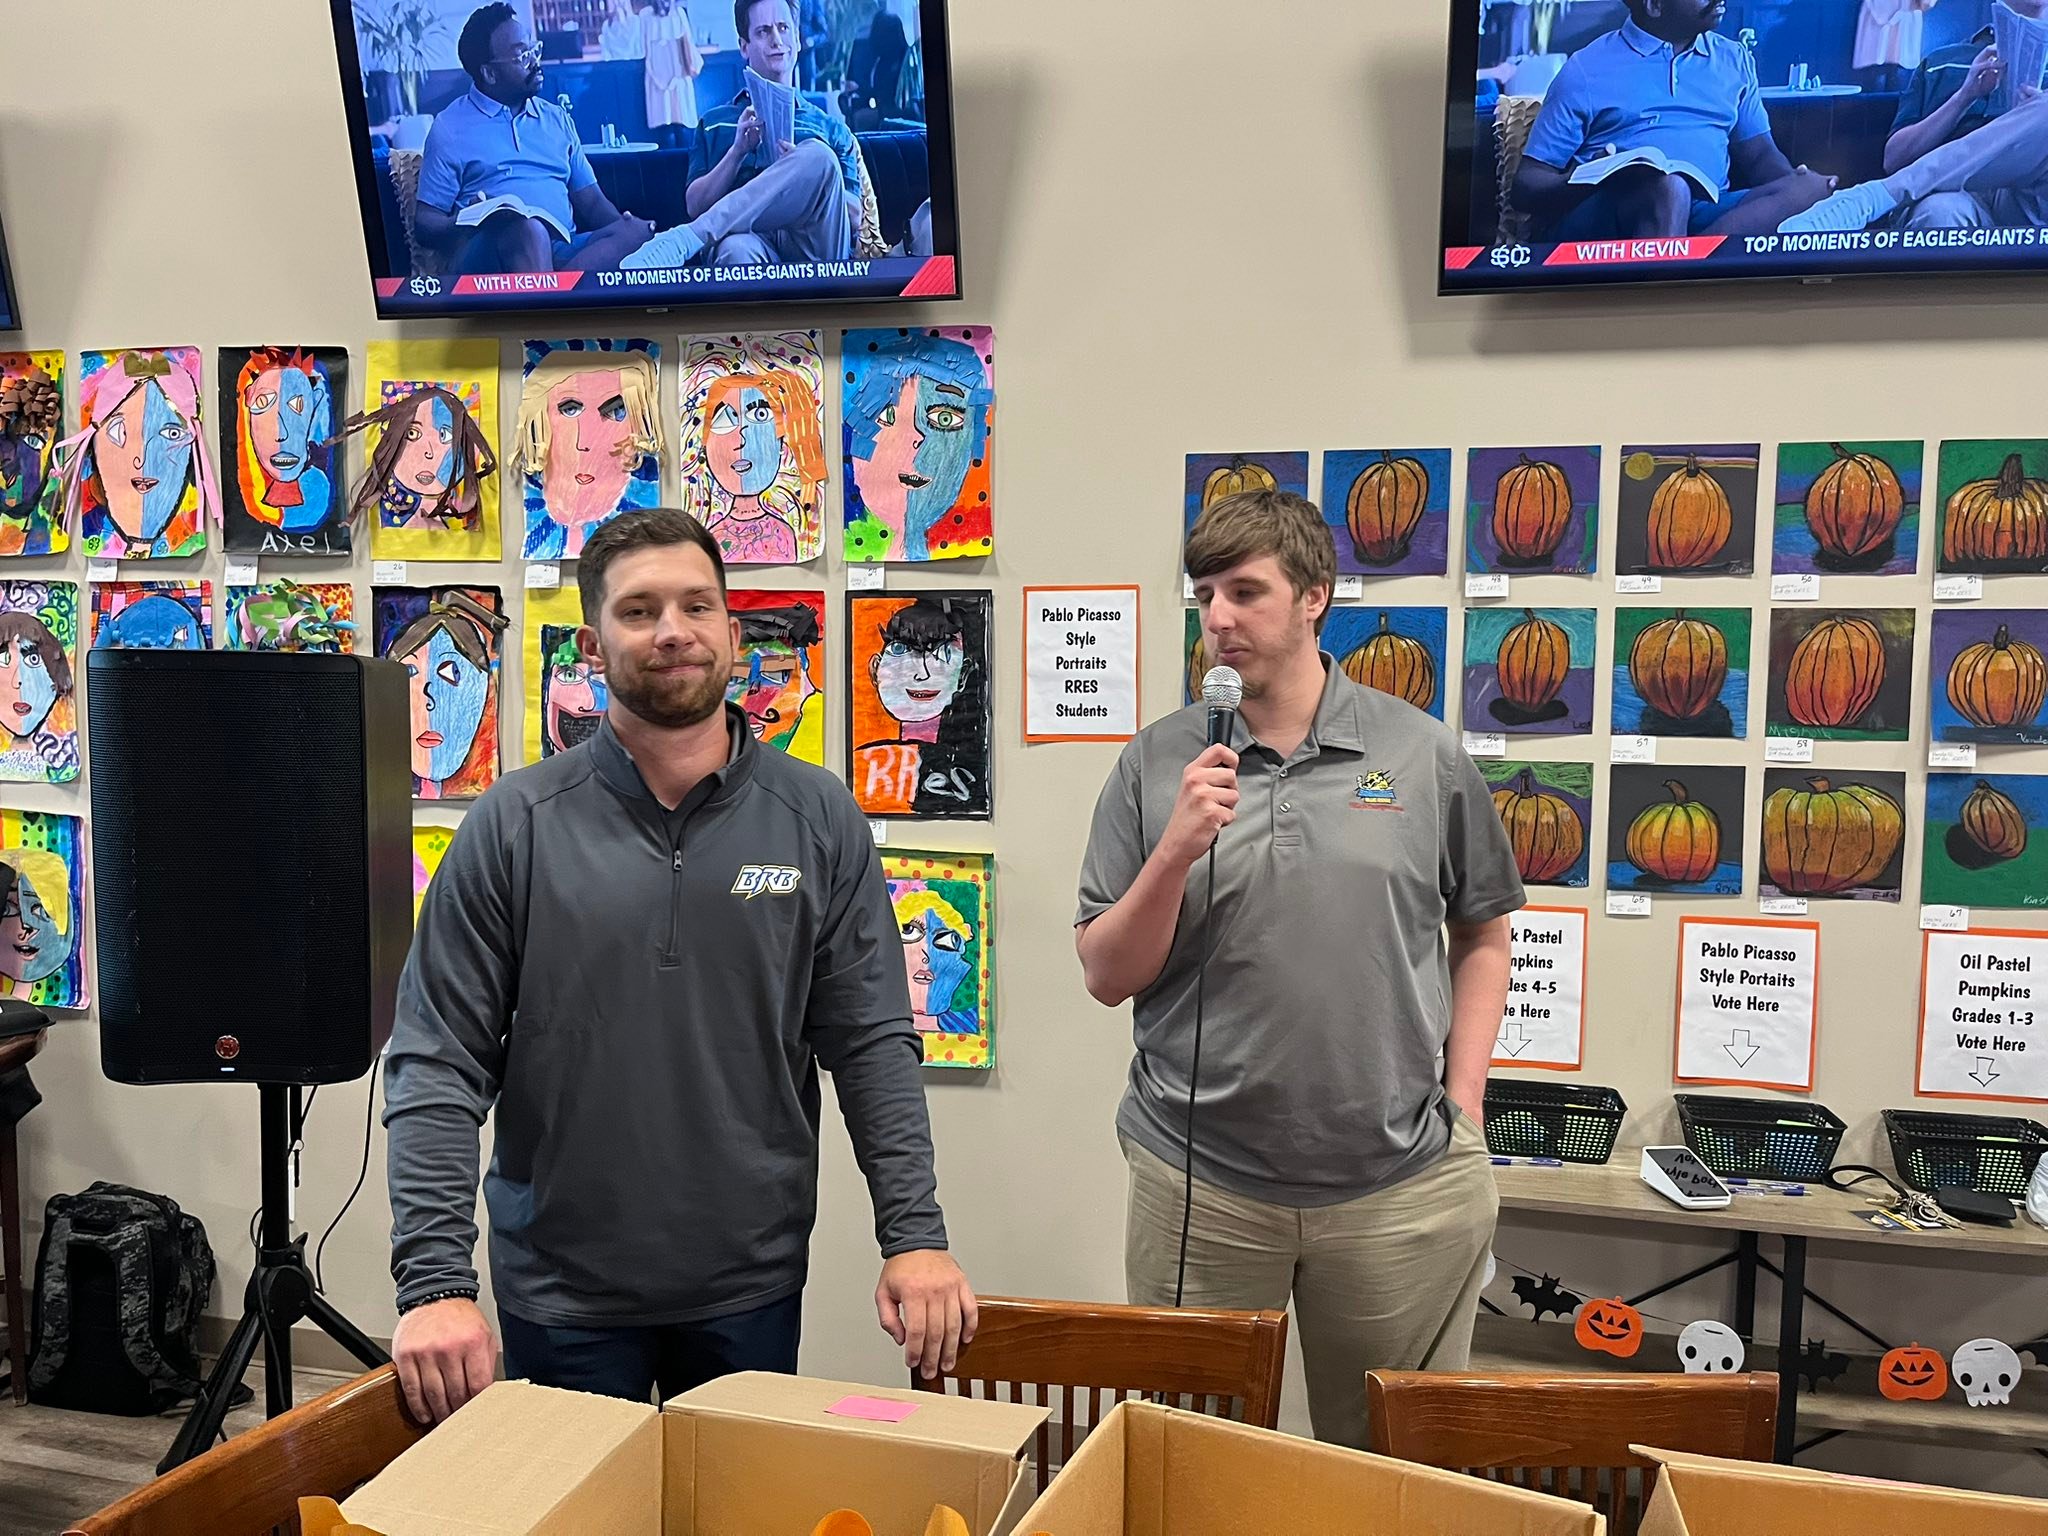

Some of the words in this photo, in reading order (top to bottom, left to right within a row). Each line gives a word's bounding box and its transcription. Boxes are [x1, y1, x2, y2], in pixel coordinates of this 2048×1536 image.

[1743, 235, 1778, 253] TOP
[1782, 232, 1870, 252] MOMENTS
[1874, 231, 1900, 248] OF
[1902, 228, 2035, 248] EAGLES-GIANTS
[1575, 242, 1625, 261] WITH
[1630, 239, 1690, 259] KEVIN
[473, 274, 512, 291] WITH
[514, 273, 559, 290] KEVIN
[596, 271, 623, 287] TOP
[625, 268, 691, 286] MOMENTS
[693, 267, 711, 283] OF
[714, 263, 815, 282] EAGLES-GIANTS
[817, 261, 870, 278] RIVALRY
[259, 531, 330, 553] Axel
[1642, 576, 1652, 584] 49
[1801, 574, 1812, 583] 50
[1967, 575, 1977, 584] 51
[1042, 608, 1074, 622] Pablo
[1078, 607, 1121, 621] Picasso
[1066, 631, 1096, 649] Style
[1055, 656, 1107, 670] Portraits
[1064, 679, 1099, 693] RRES
[1055, 703, 1108, 717] Students
[1487, 733, 1499, 742] 56
[1637, 738, 1648, 747] 57
[1960, 745, 1970, 753] 59
[733, 866, 801, 896] BRB
[1632, 895, 1644, 903] 65
[1950, 909, 1962, 917] 67
[1523, 928, 1562, 944] Pastel
[1701, 942, 1738, 959] Pablo
[1743, 944, 1796, 962] Picasso
[1511, 953, 1553, 971] mpkins
[1960, 954, 1982, 970] Oil
[1987, 955, 2031, 972] Pastel
[1699, 968, 1735, 988] Style
[1739, 970, 1795, 988] Portaits
[1532, 980, 1557, 994] 4-5
[1958, 980, 2031, 1001] Pumpkins
[1521, 1003, 1550, 1018] Here
[1712, 994, 1742, 1010] Vote
[1747, 996, 1779, 1012] Here
[1952, 1007, 2001, 1024] Grades
[2008, 1011, 2034, 1025] 1-3
[1956, 1033, 1987, 1049] Vote
[1993, 1035, 2026, 1051] Here
